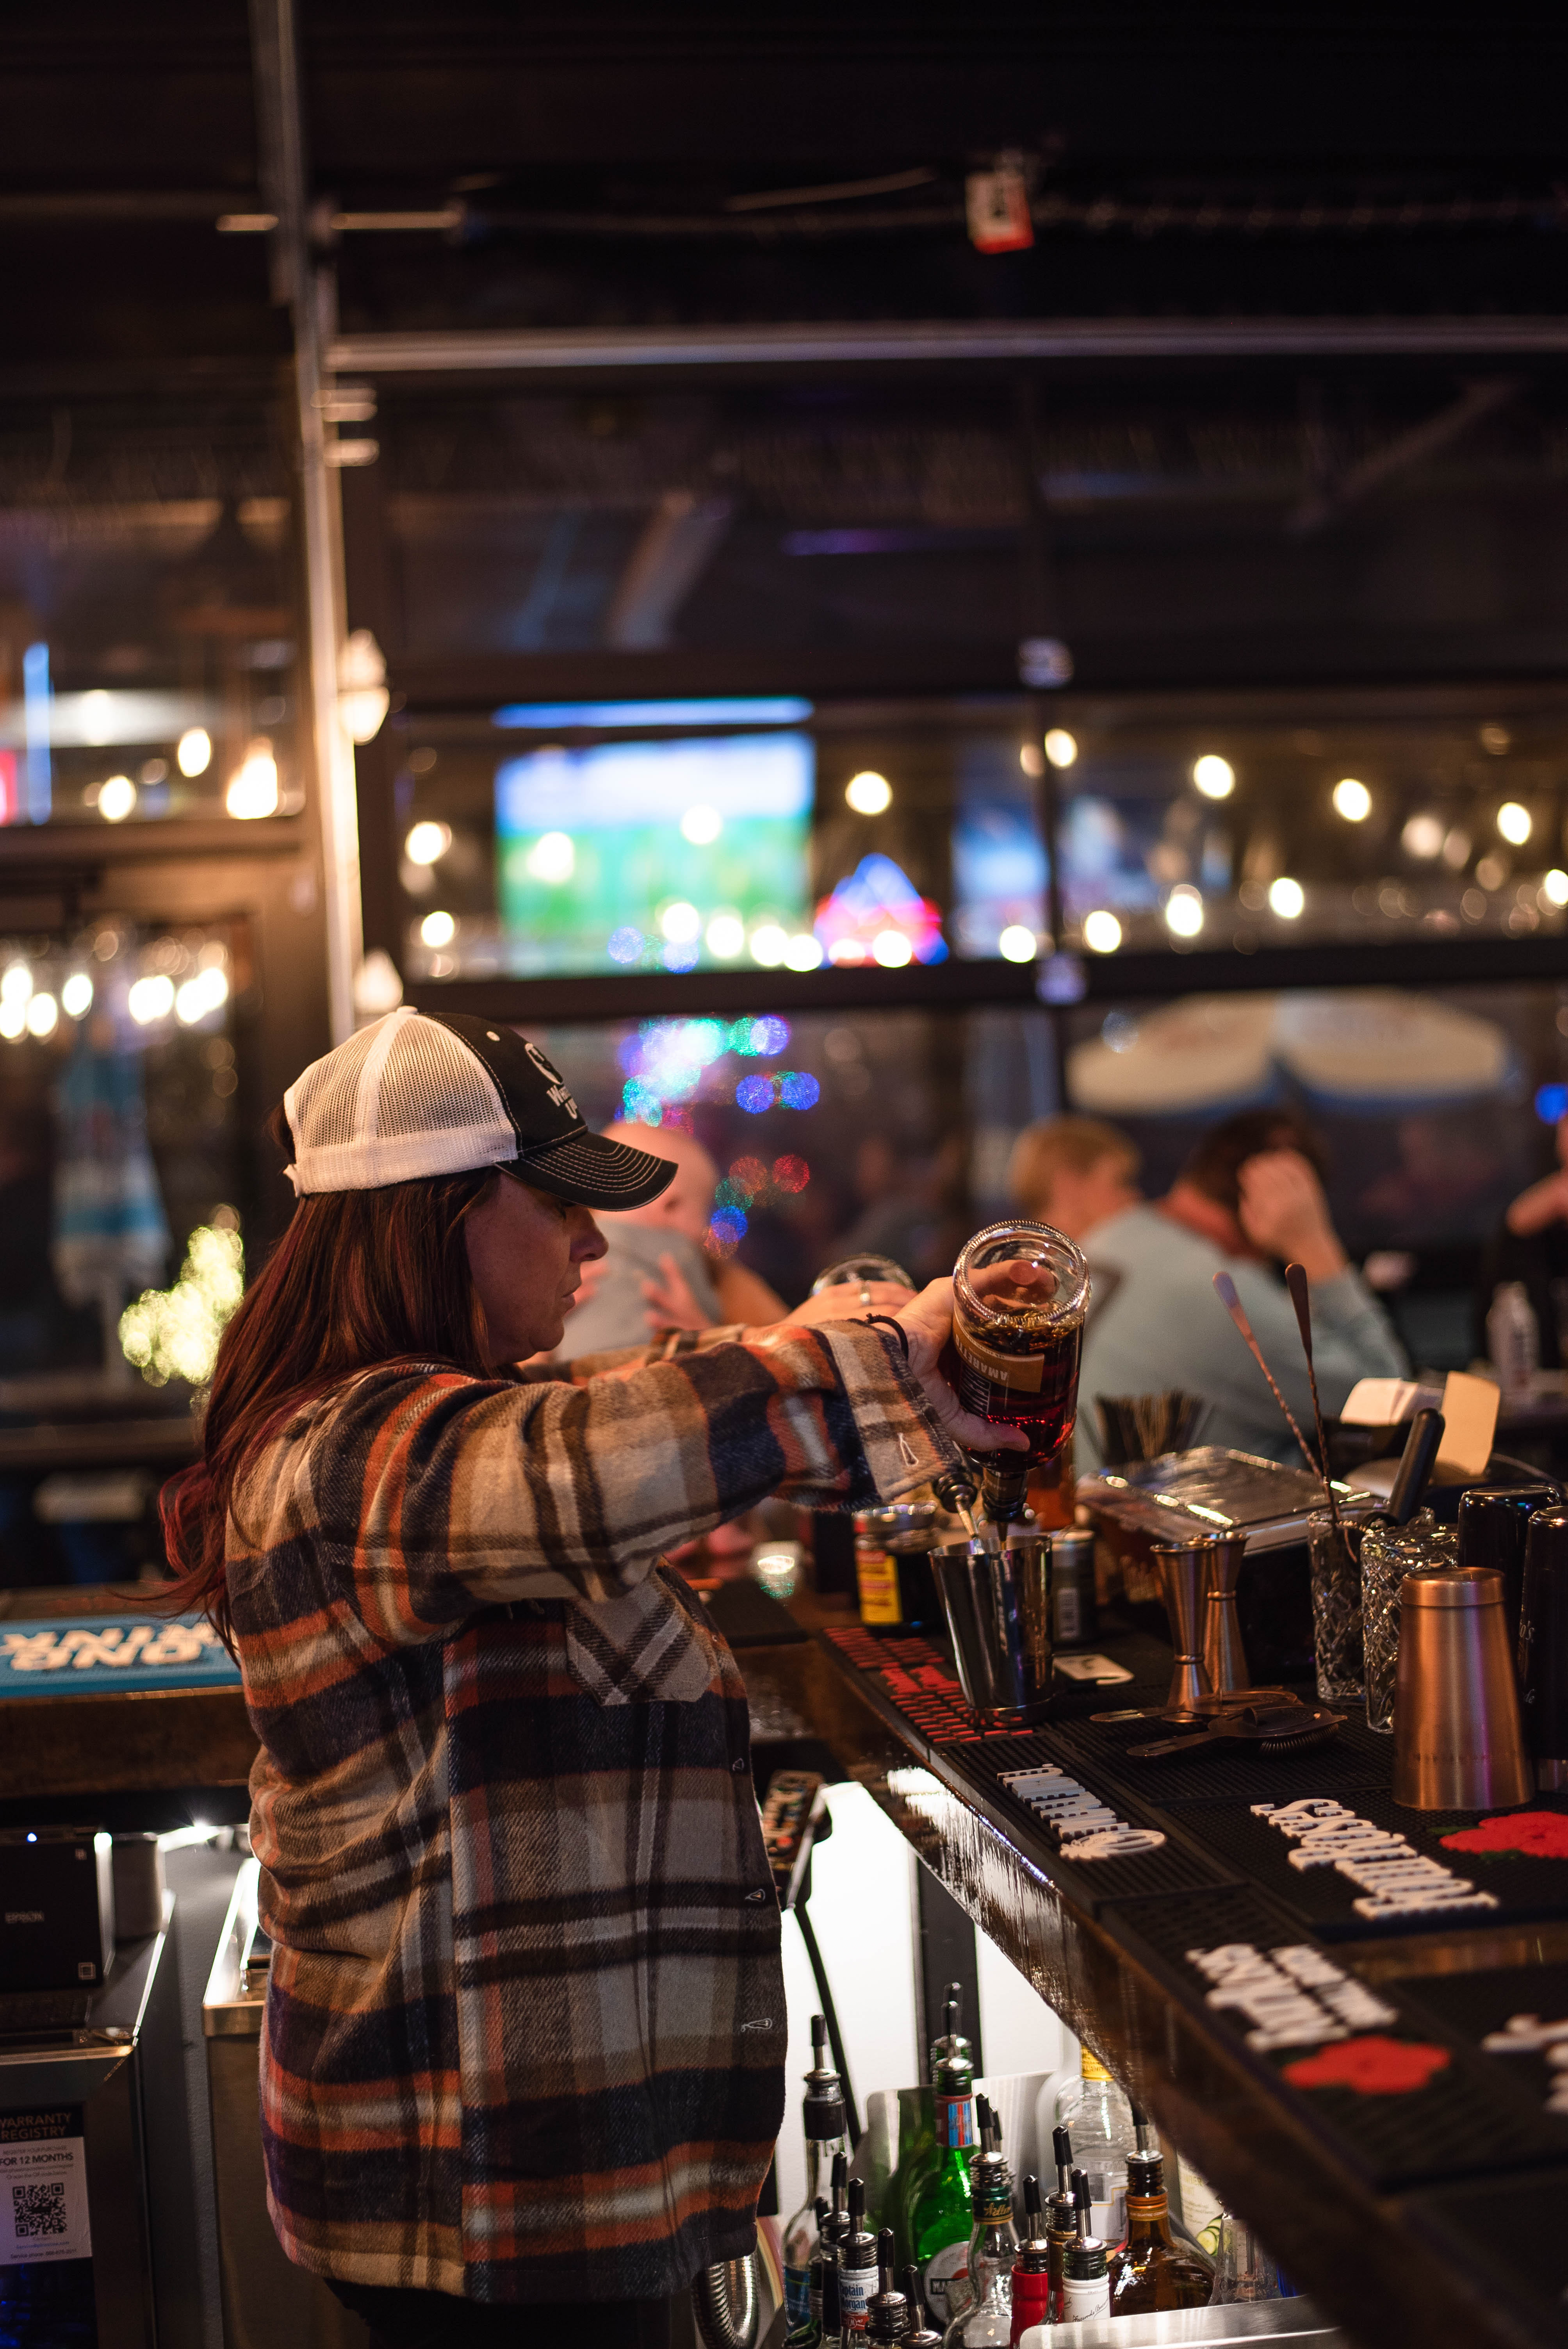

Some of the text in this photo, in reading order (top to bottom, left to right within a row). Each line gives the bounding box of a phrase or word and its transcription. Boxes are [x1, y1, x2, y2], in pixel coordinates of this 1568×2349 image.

[1, 2125, 66, 2140] REGISTRY
[0, 2152, 73, 2166] FOR 12 MONTHS
